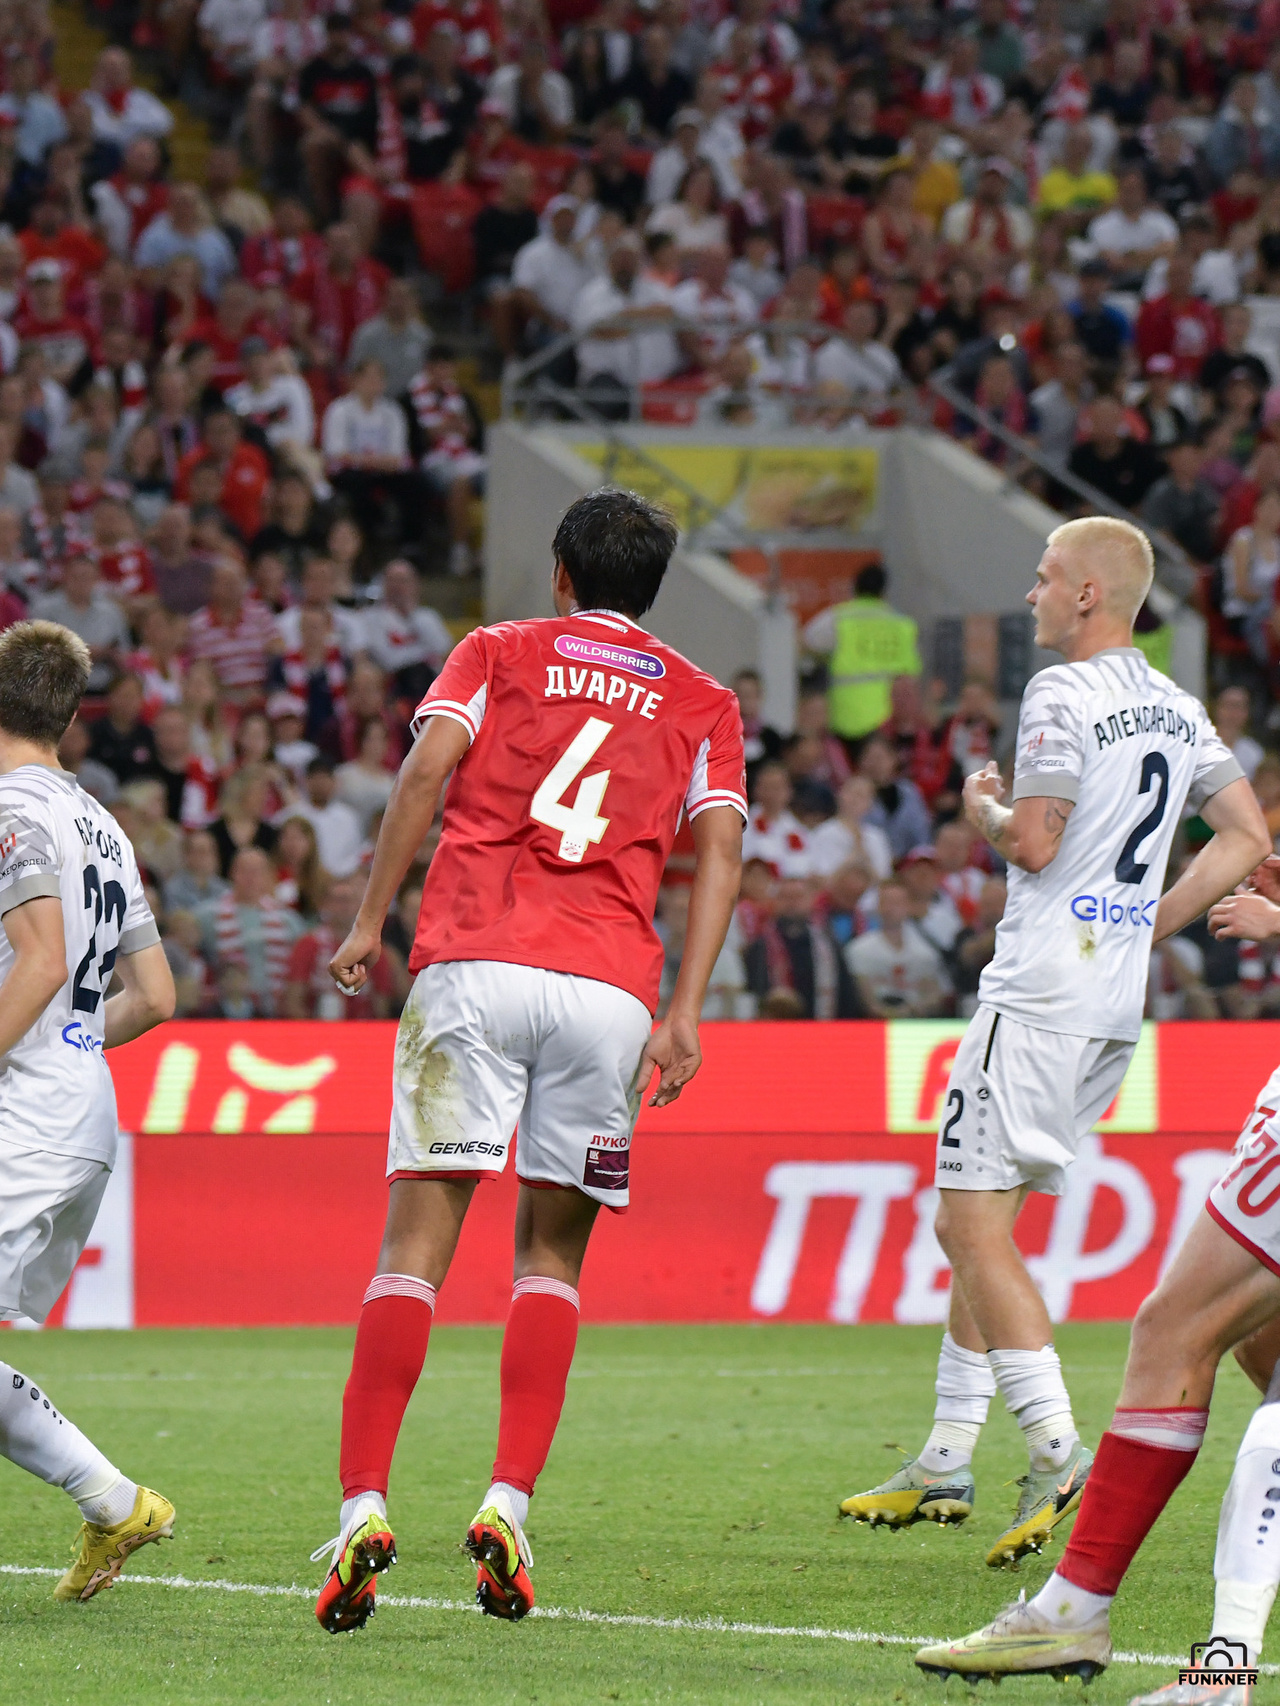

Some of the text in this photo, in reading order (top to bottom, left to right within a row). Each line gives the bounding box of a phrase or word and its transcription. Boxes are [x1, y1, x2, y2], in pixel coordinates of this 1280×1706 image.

[565, 641, 657, 672] WILDBERRIES
[544, 666, 663, 720] ДУАРТЕ
[530, 716, 614, 863] 4
[1115, 751, 1169, 885] 2
[72, 864, 127, 1014] 22
[590, 1135, 630, 1148] ЛУКО
[942, 1088, 964, 1148] 2
[429, 1140, 505, 1157] GENESIS
